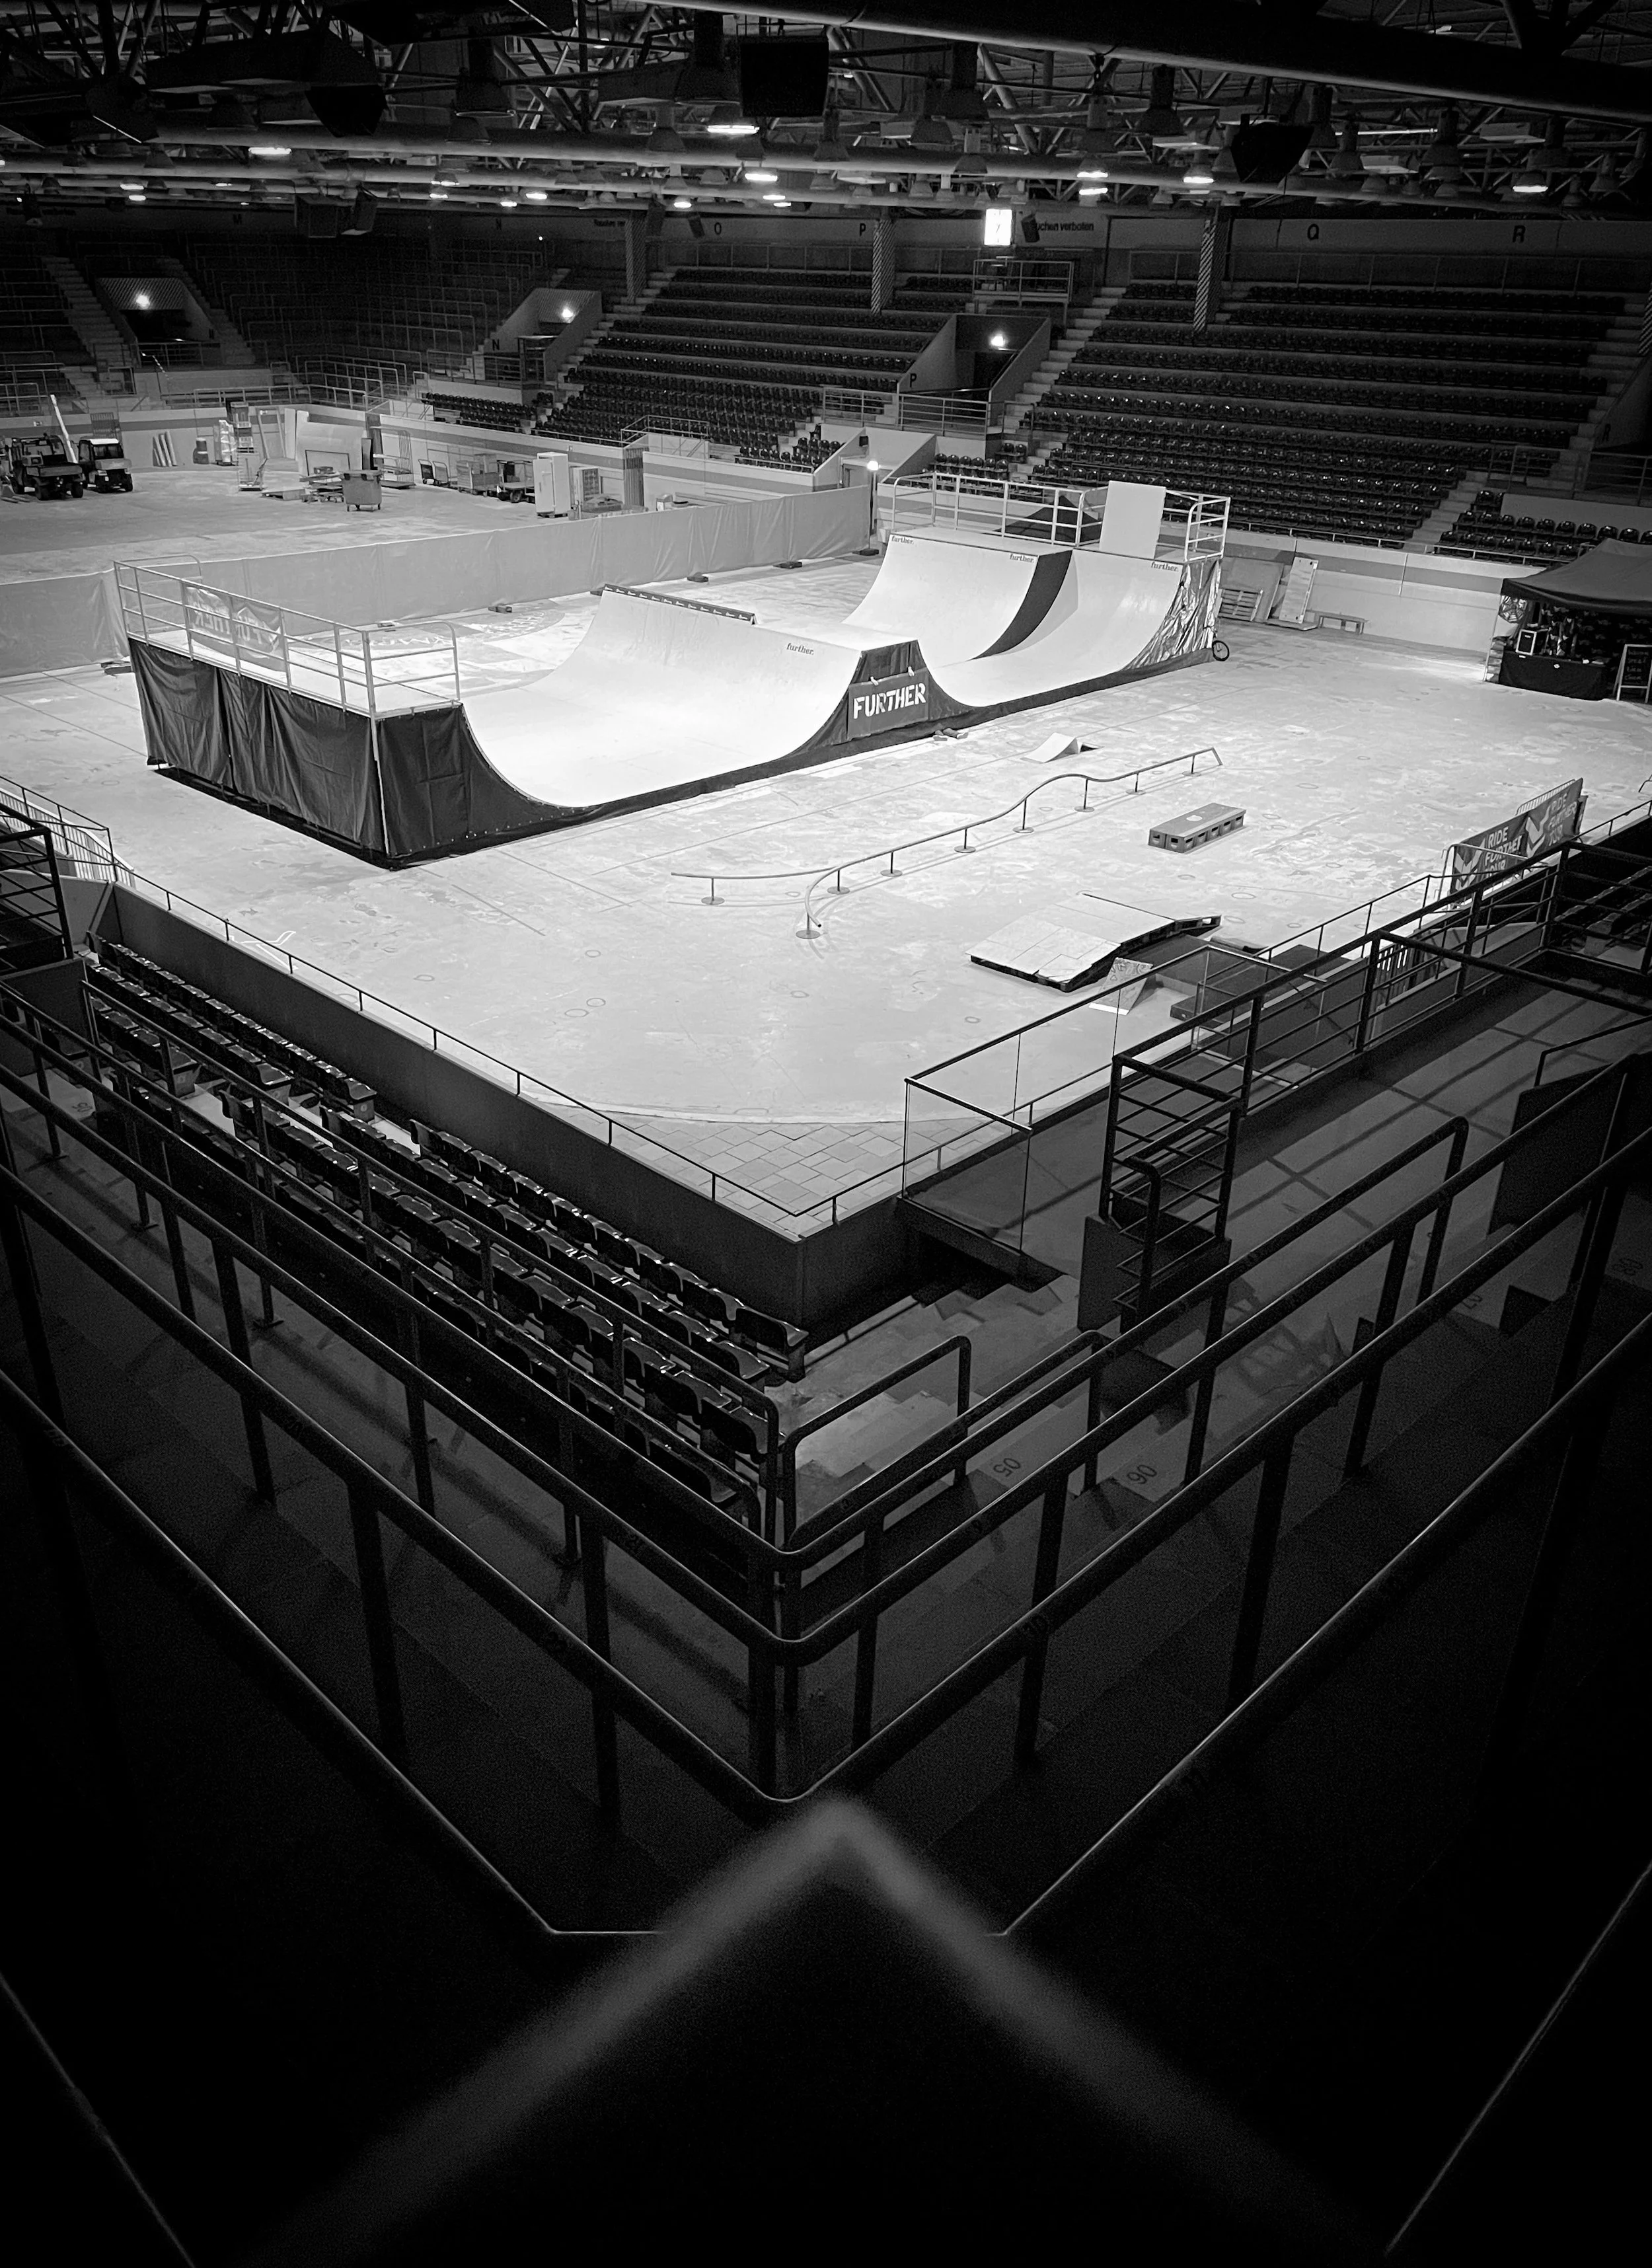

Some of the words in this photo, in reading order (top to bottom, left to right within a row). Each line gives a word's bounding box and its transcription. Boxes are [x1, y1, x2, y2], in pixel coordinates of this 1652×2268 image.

[860, 223, 866, 237] P
[1060, 222, 1094, 231] verboten
[1307, 223, 1320, 241] Q
[1513, 225, 1526, 243] R
[492, 339, 500, 350] N
[910, 373, 917, 388] P
[786, 642, 815, 656] further.
[853, 683, 926, 720] FURTHER
[1488, 826, 1509, 849] RIDE
[993, 1458, 1021, 1477] 05
[1127, 1464, 1157, 1484] 06
